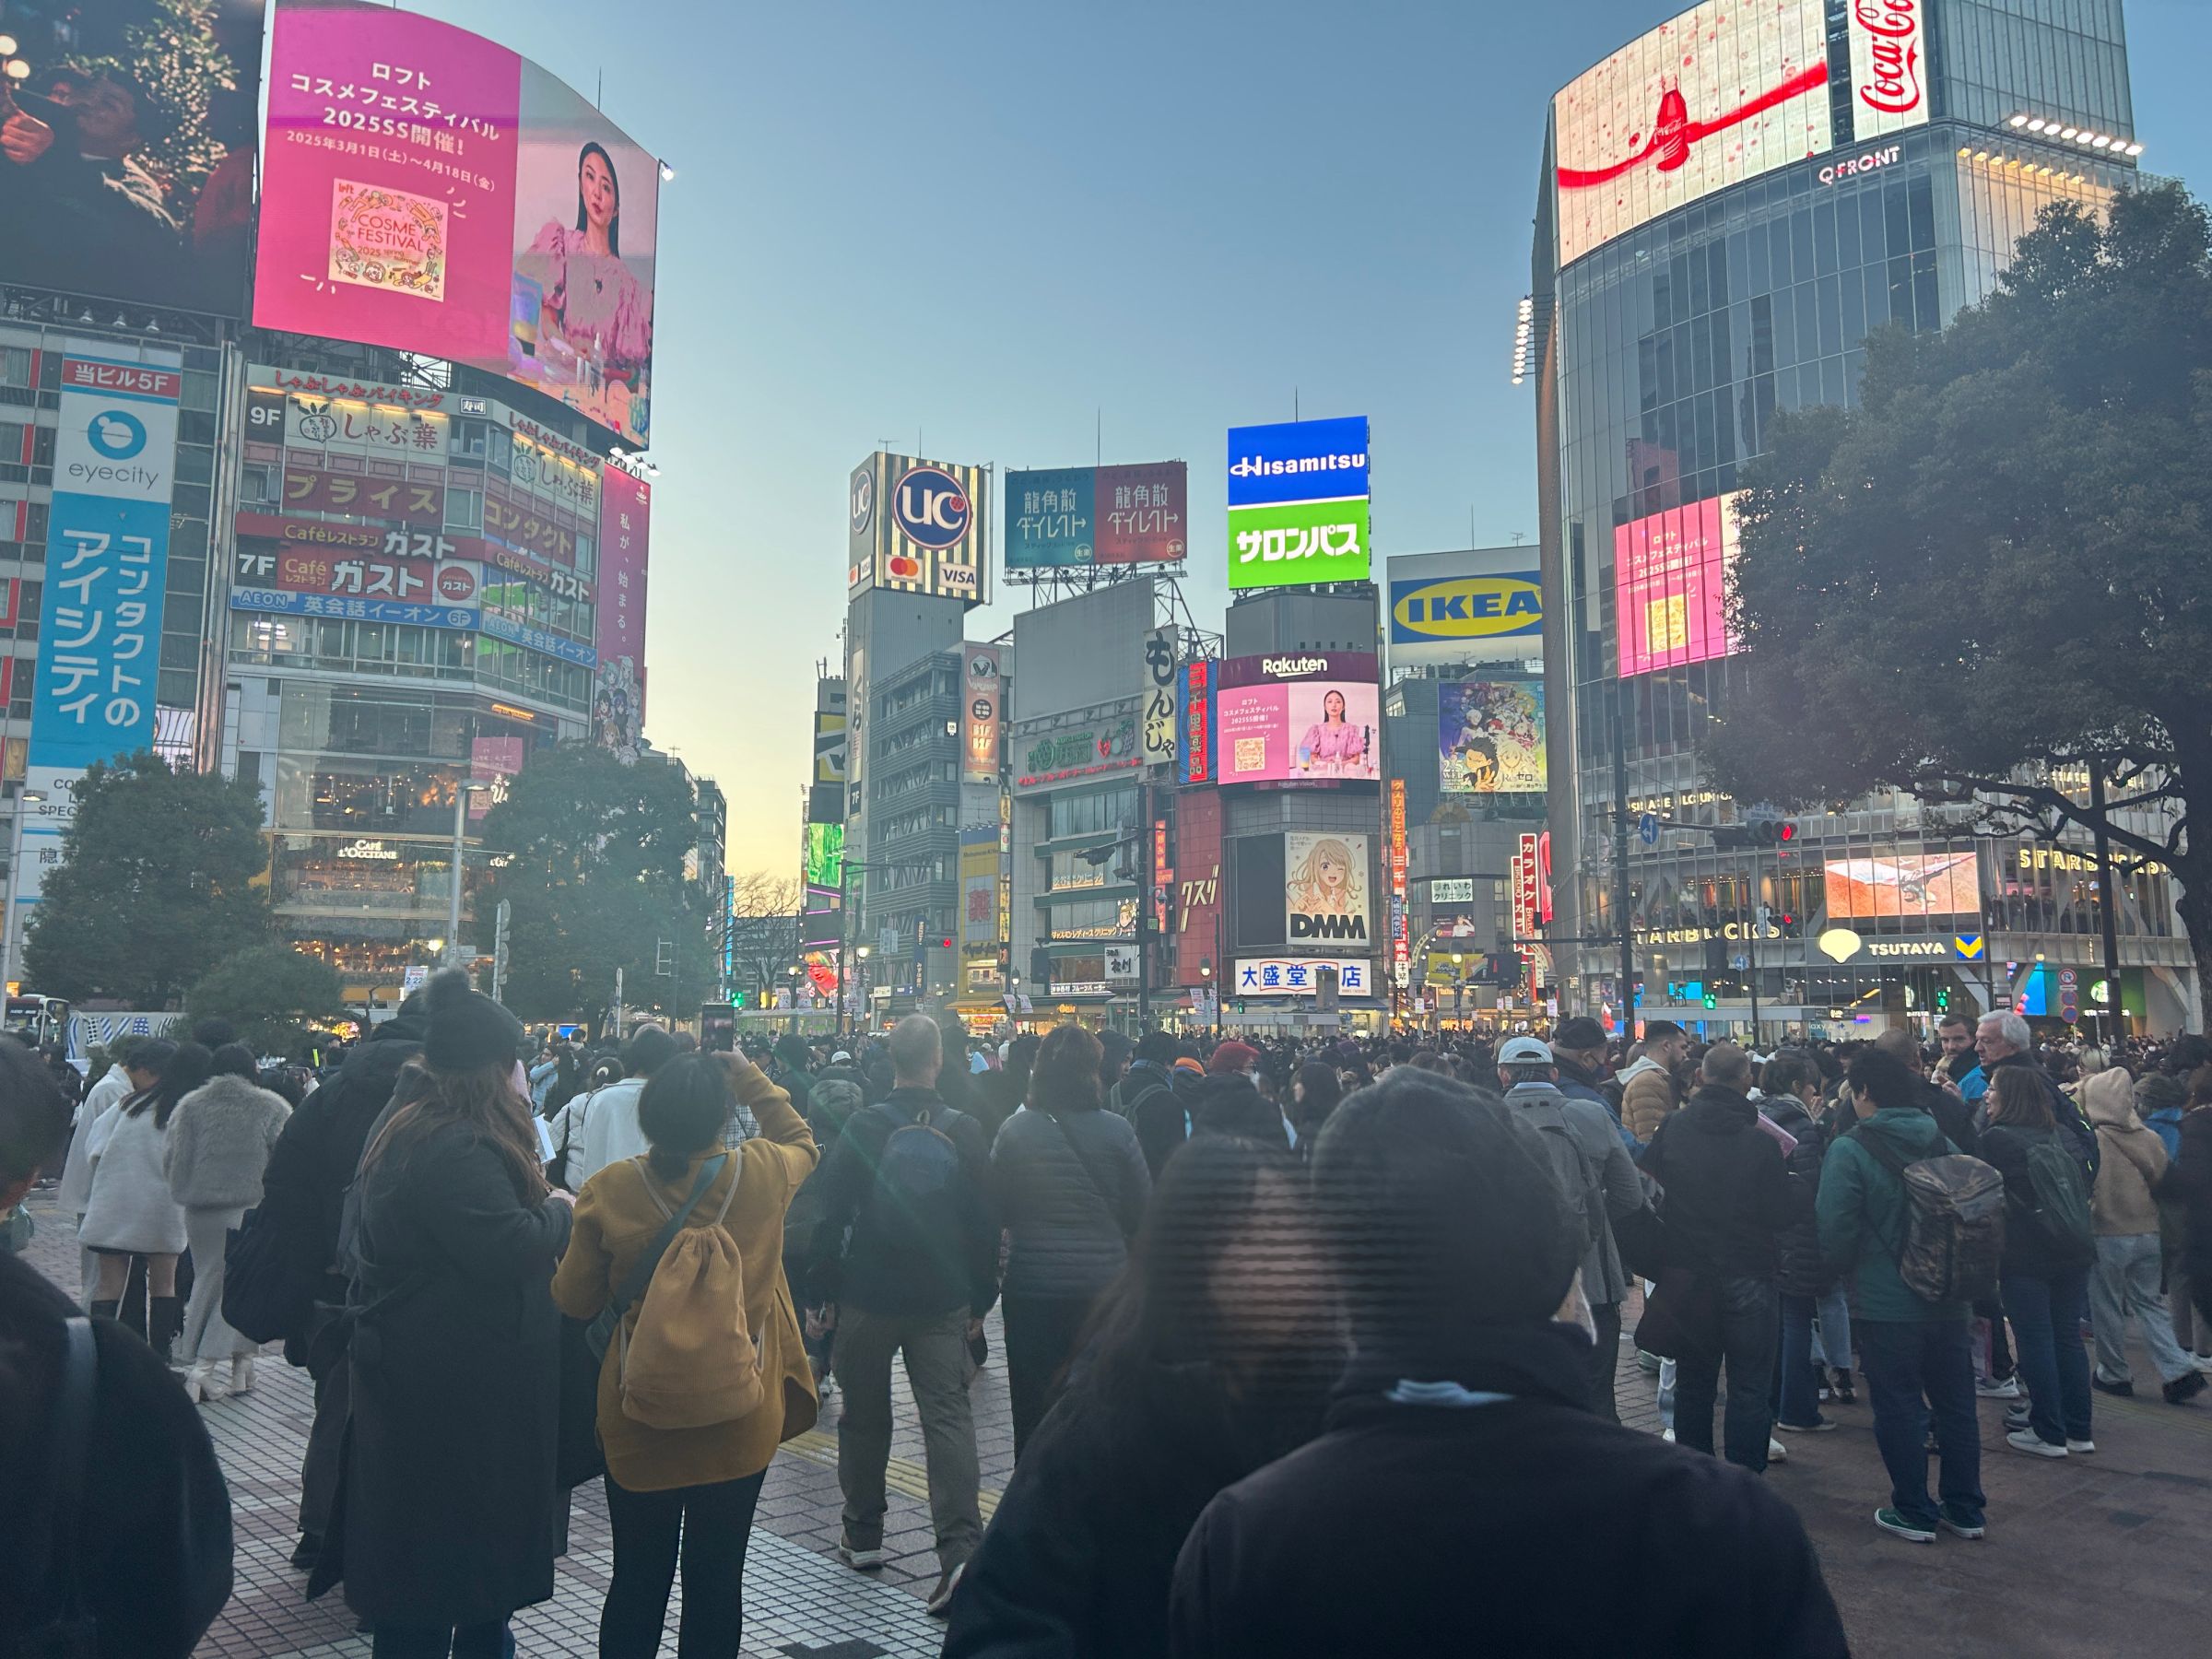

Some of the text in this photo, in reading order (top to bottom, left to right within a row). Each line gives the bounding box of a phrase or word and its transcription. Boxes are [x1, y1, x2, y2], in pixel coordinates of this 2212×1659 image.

[372, 62, 431, 90] ロフト
[290, 73, 500, 141] コスメフェスティバル
[1818, 146, 1900, 185] QFRONT
[358, 214, 417, 236] COSME
[357, 245, 382, 257] 2025
[358, 228, 424, 253] FESTIVAL
[75, 364, 170, 394] 当ビル5F
[276, 370, 445, 408] しゃぶしゃぶバイキング
[250, 406, 281, 426] 9F
[344, 413, 438, 451] しゃぶ葉
[509, 411, 601, 469] しゃぶしゃぶバイキング
[67, 461, 159, 489] eyecity
[1230, 453, 1365, 477] Hisamitsu
[287, 475, 439, 515] プライス
[541, 459, 594, 506] しゃぶ葉
[853, 483, 869, 520] UC
[902, 485, 964, 531] UC
[1024, 488, 1077, 514] 龍角散
[1115, 483, 1168, 510] 龍角散
[485, 499, 572, 556] コンタクト
[1017, 513, 1087, 540] ダイレクト
[1107, 509, 1179, 535] ダイレクト
[383, 530, 456, 560] ガスト
[1236, 523, 1360, 563] サロンパス
[238, 553, 276, 576] 7F
[284, 558, 327, 576] Café
[330, 559, 425, 597] ガスト
[617, 512, 631, 642] 私が、始まる。
[942, 568, 975, 585] VISA
[284, 575, 325, 587] レストラン
[441, 581, 472, 593] ガスト
[549, 572, 590, 602] ガスト
[239, 592, 288, 608] AEON
[1408, 589, 1541, 623] IKEA
[51, 528, 112, 724] アイシティ
[104, 535, 152, 728] コンタクトの
[447, 610, 471, 627] 6F
[1262, 656, 1328, 678] Rakuten
[1145, 630, 1176, 759] もんじゃ
[1241, 698, 1258, 706] ロフト
[1189, 668, 1203, 776] 三千里薬品
[1223, 705, 1280, 717] コスメフェスティバル
[852, 791, 861, 805] 7F
[1524, 842, 1536, 900] カラオケ
[1434, 891, 1472, 901] クリニック
[1442, 882, 1472, 891] れいわ
[1290, 913, 1367, 939] DMM
[1868, 941, 1947, 957] TSUTAYA
